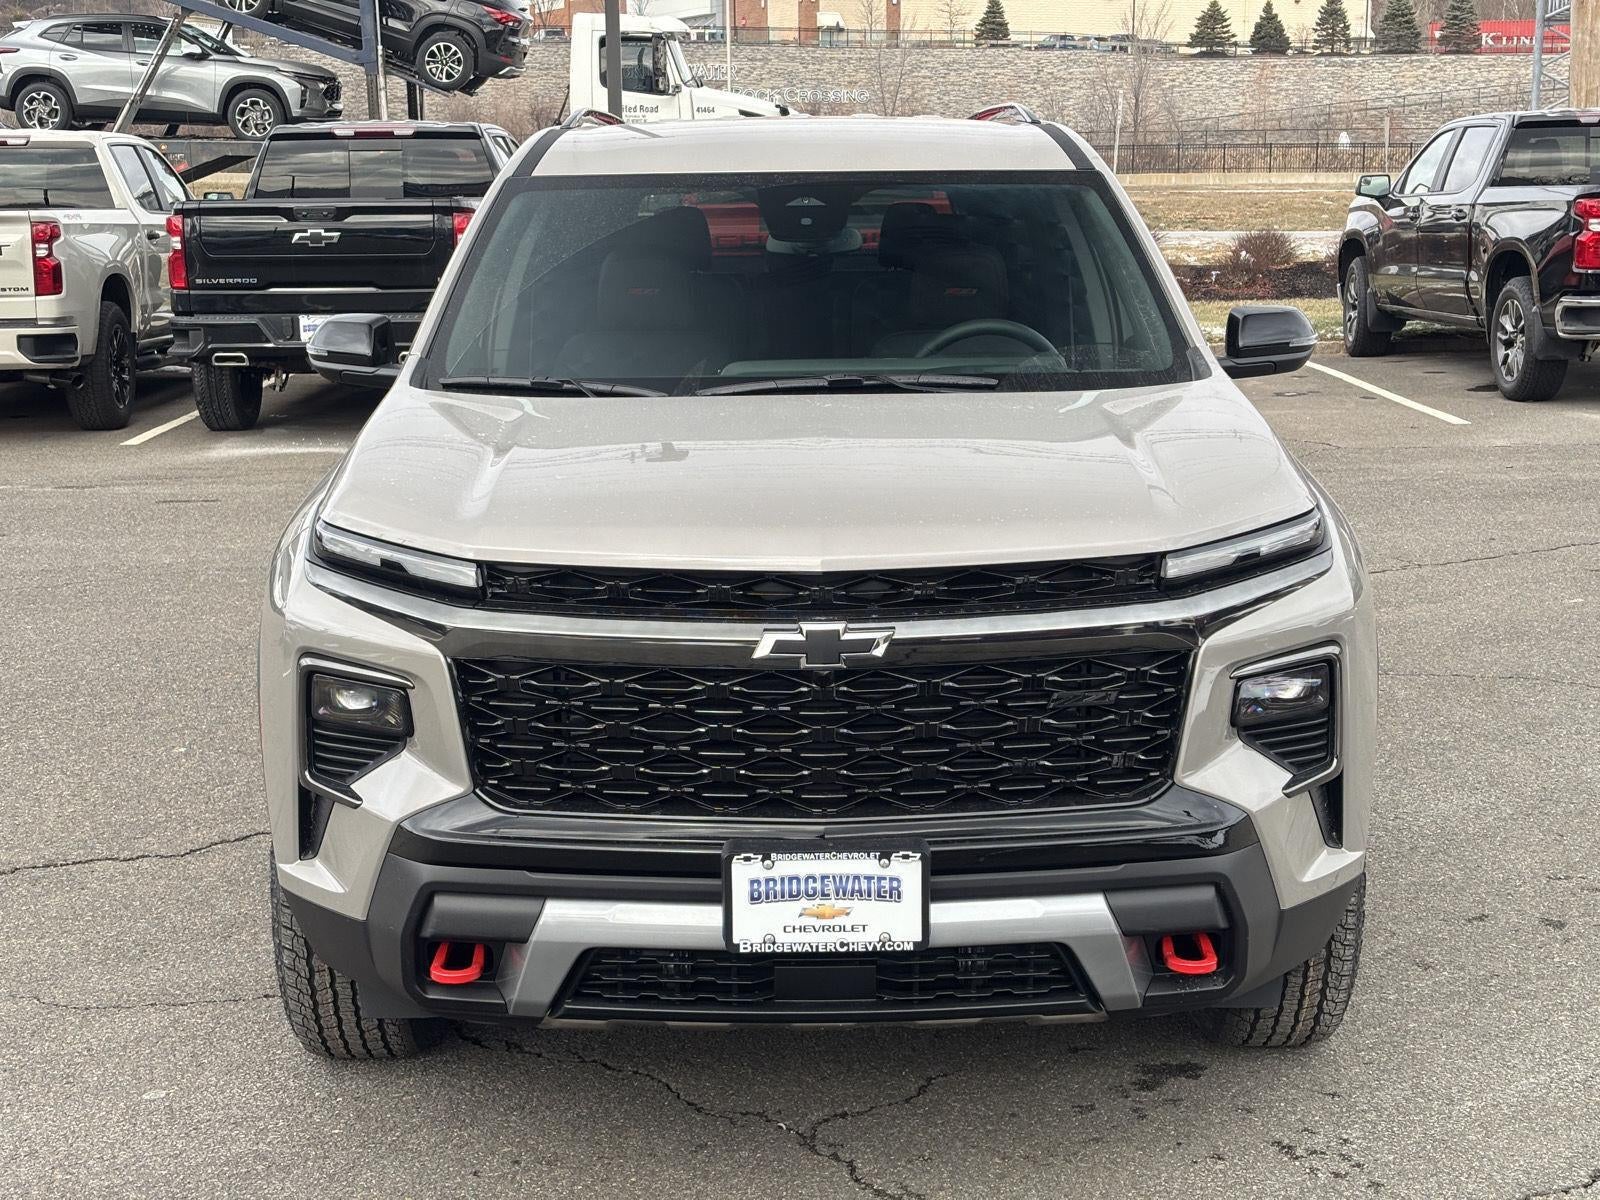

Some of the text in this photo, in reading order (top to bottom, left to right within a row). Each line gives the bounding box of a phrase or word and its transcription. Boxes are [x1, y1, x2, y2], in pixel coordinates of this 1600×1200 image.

[784, 86, 870, 104] CROSSING
[639, 104, 659, 113] Road
[770, 851, 880, 861] BRIDGEWATERCHEVROLET
[748, 873, 903, 904] BRIDGEWATER
[783, 924, 869, 934] CHEVROLET
